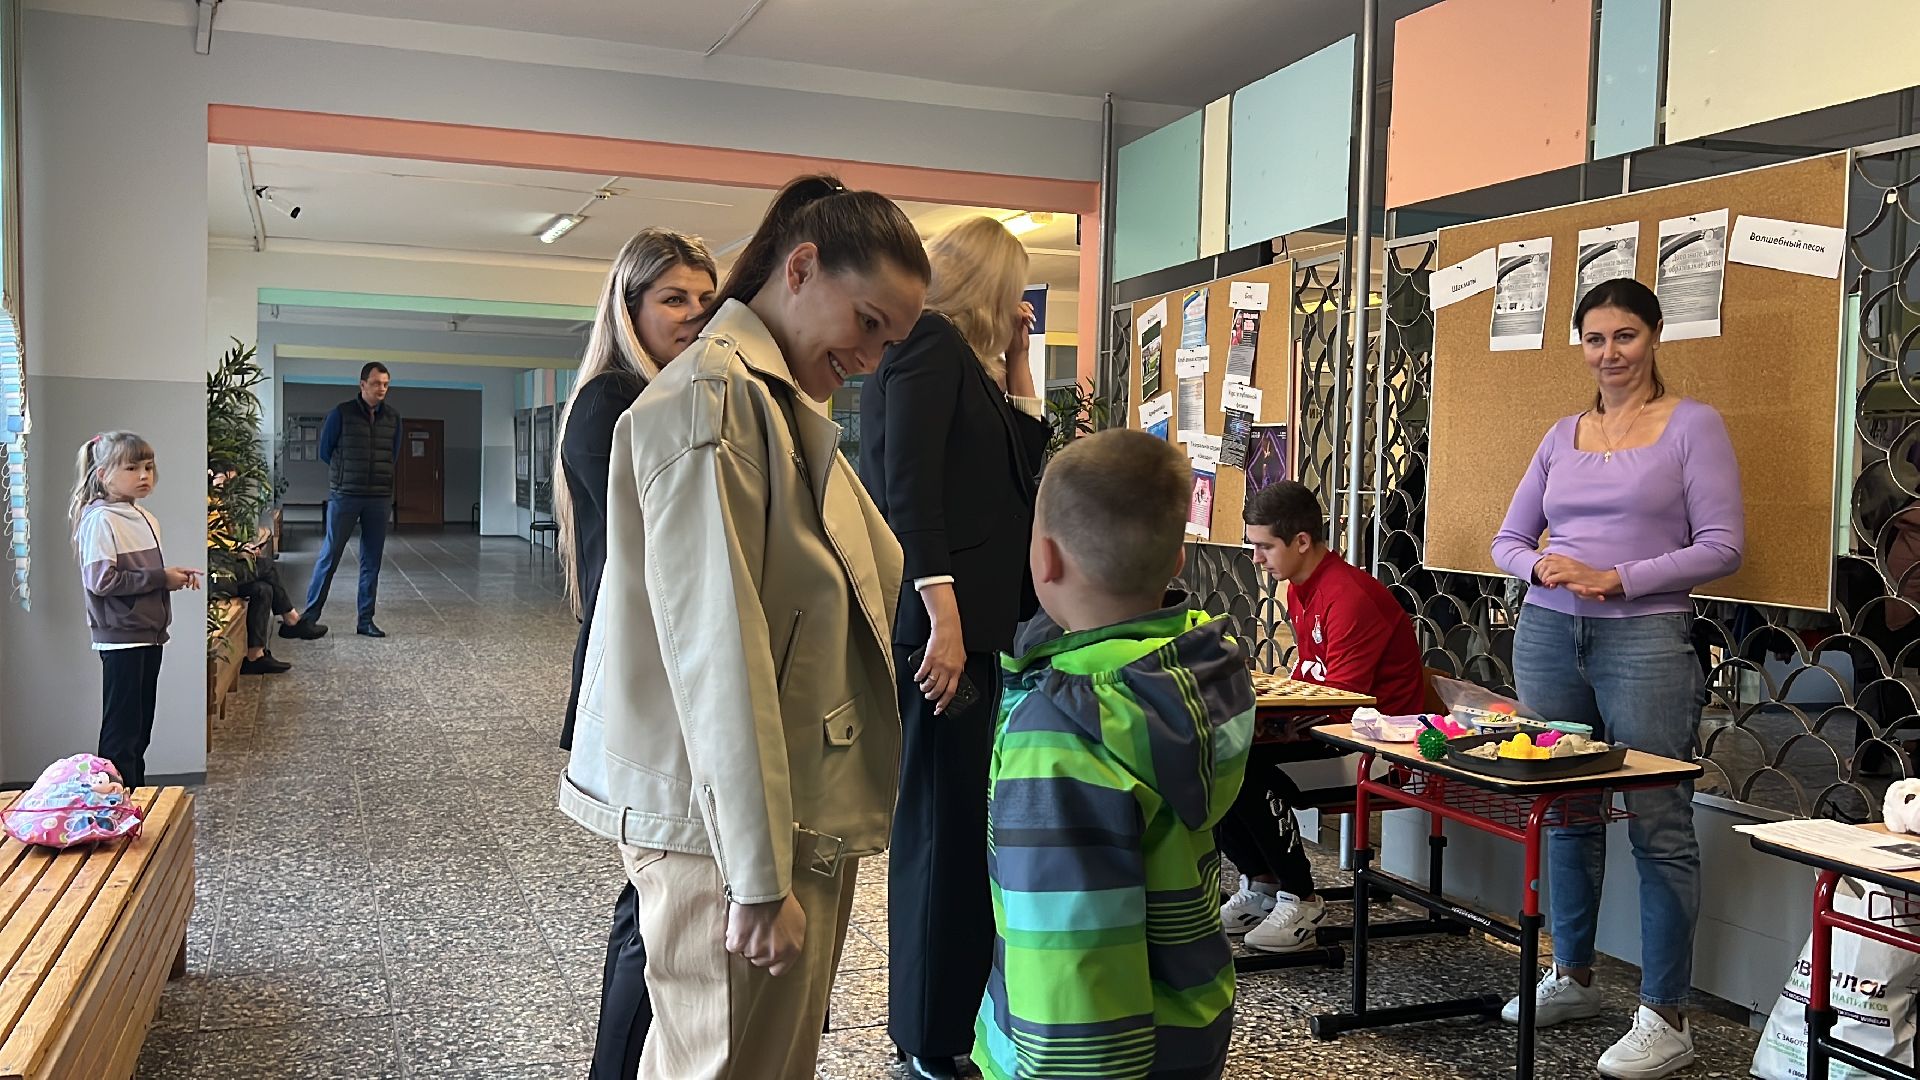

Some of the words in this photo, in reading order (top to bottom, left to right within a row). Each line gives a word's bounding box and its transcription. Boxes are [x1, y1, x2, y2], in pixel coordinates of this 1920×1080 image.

[1749, 231, 1802, 249] Волшебный
[1802, 242, 1826, 253] песок
[1451, 277, 1477, 293] Шахматы
